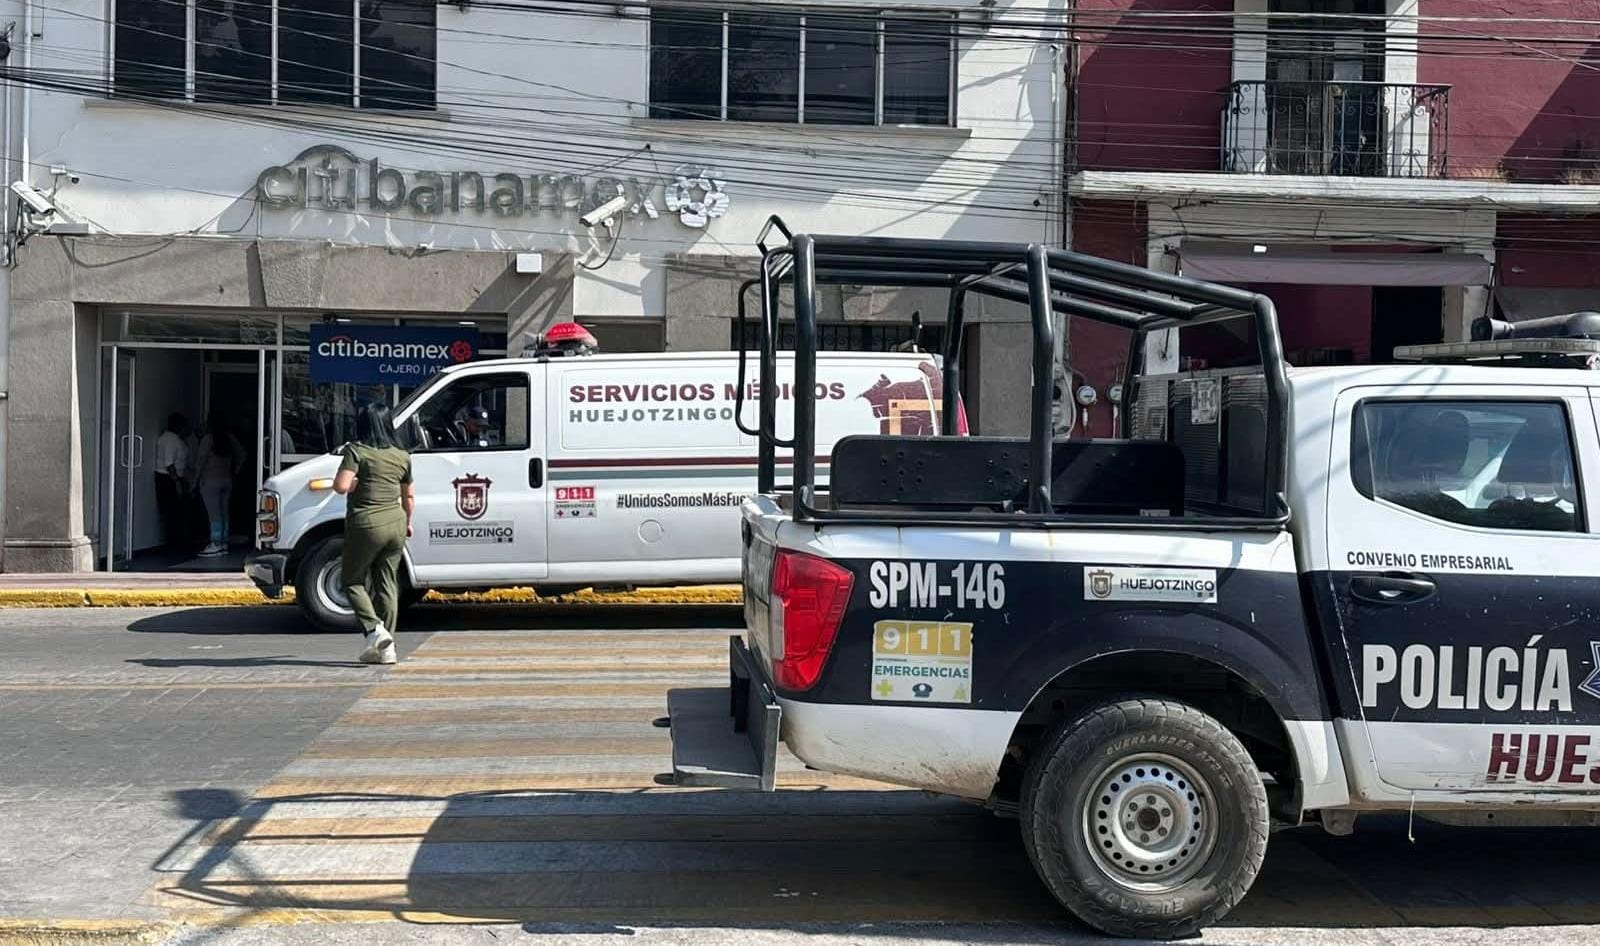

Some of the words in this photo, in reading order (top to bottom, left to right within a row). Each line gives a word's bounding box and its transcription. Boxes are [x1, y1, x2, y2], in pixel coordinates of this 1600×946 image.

[257, 157, 659, 219] citibanamex
[318, 340, 449, 359] citibanamex
[379, 364, 421, 374] CAJERO
[569, 383, 715, 403] SERVICIOS
[569, 407, 733, 423] HUEJOTZINGO
[430, 527, 513, 539] HUEJOTZINGO
[1347, 551, 1417, 567] CONVENIO
[1421, 554, 1514, 570] EMPRESARIAL
[869, 560, 1006, 610] SPM-146
[1120, 578, 1215, 591] HUEJOTZINGO
[874, 665, 969, 679] EMERGENCIAS
[1362, 634, 1573, 712] POLICÍA
